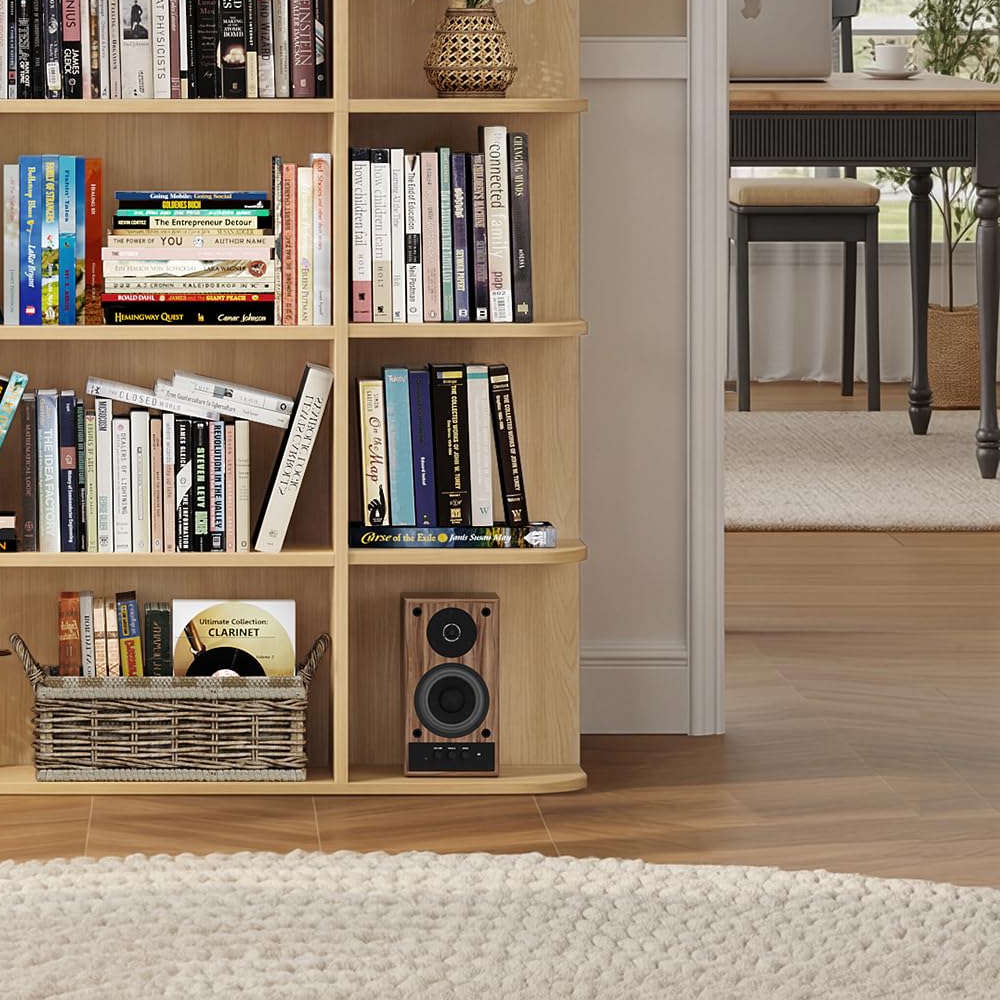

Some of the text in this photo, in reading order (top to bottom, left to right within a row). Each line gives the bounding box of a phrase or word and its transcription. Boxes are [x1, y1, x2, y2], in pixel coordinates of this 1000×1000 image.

[156, 16, 166, 80] PHYSICISTS
[260, 23, 270, 61] WIZARD
[354, 164, 366, 246] how children fail
[490, 144, 505, 258] connected family
[172, 219, 222, 227] Entrepreneur
[161, 237, 183, 246] YOU
[115, 313, 184, 322] HEMINGWAY QUEST
[44, 429, 54, 536] THE IDEA FACTORY
[361, 532, 436, 544] Curse of the Exile
[208, 628, 260, 637] CLARINET
